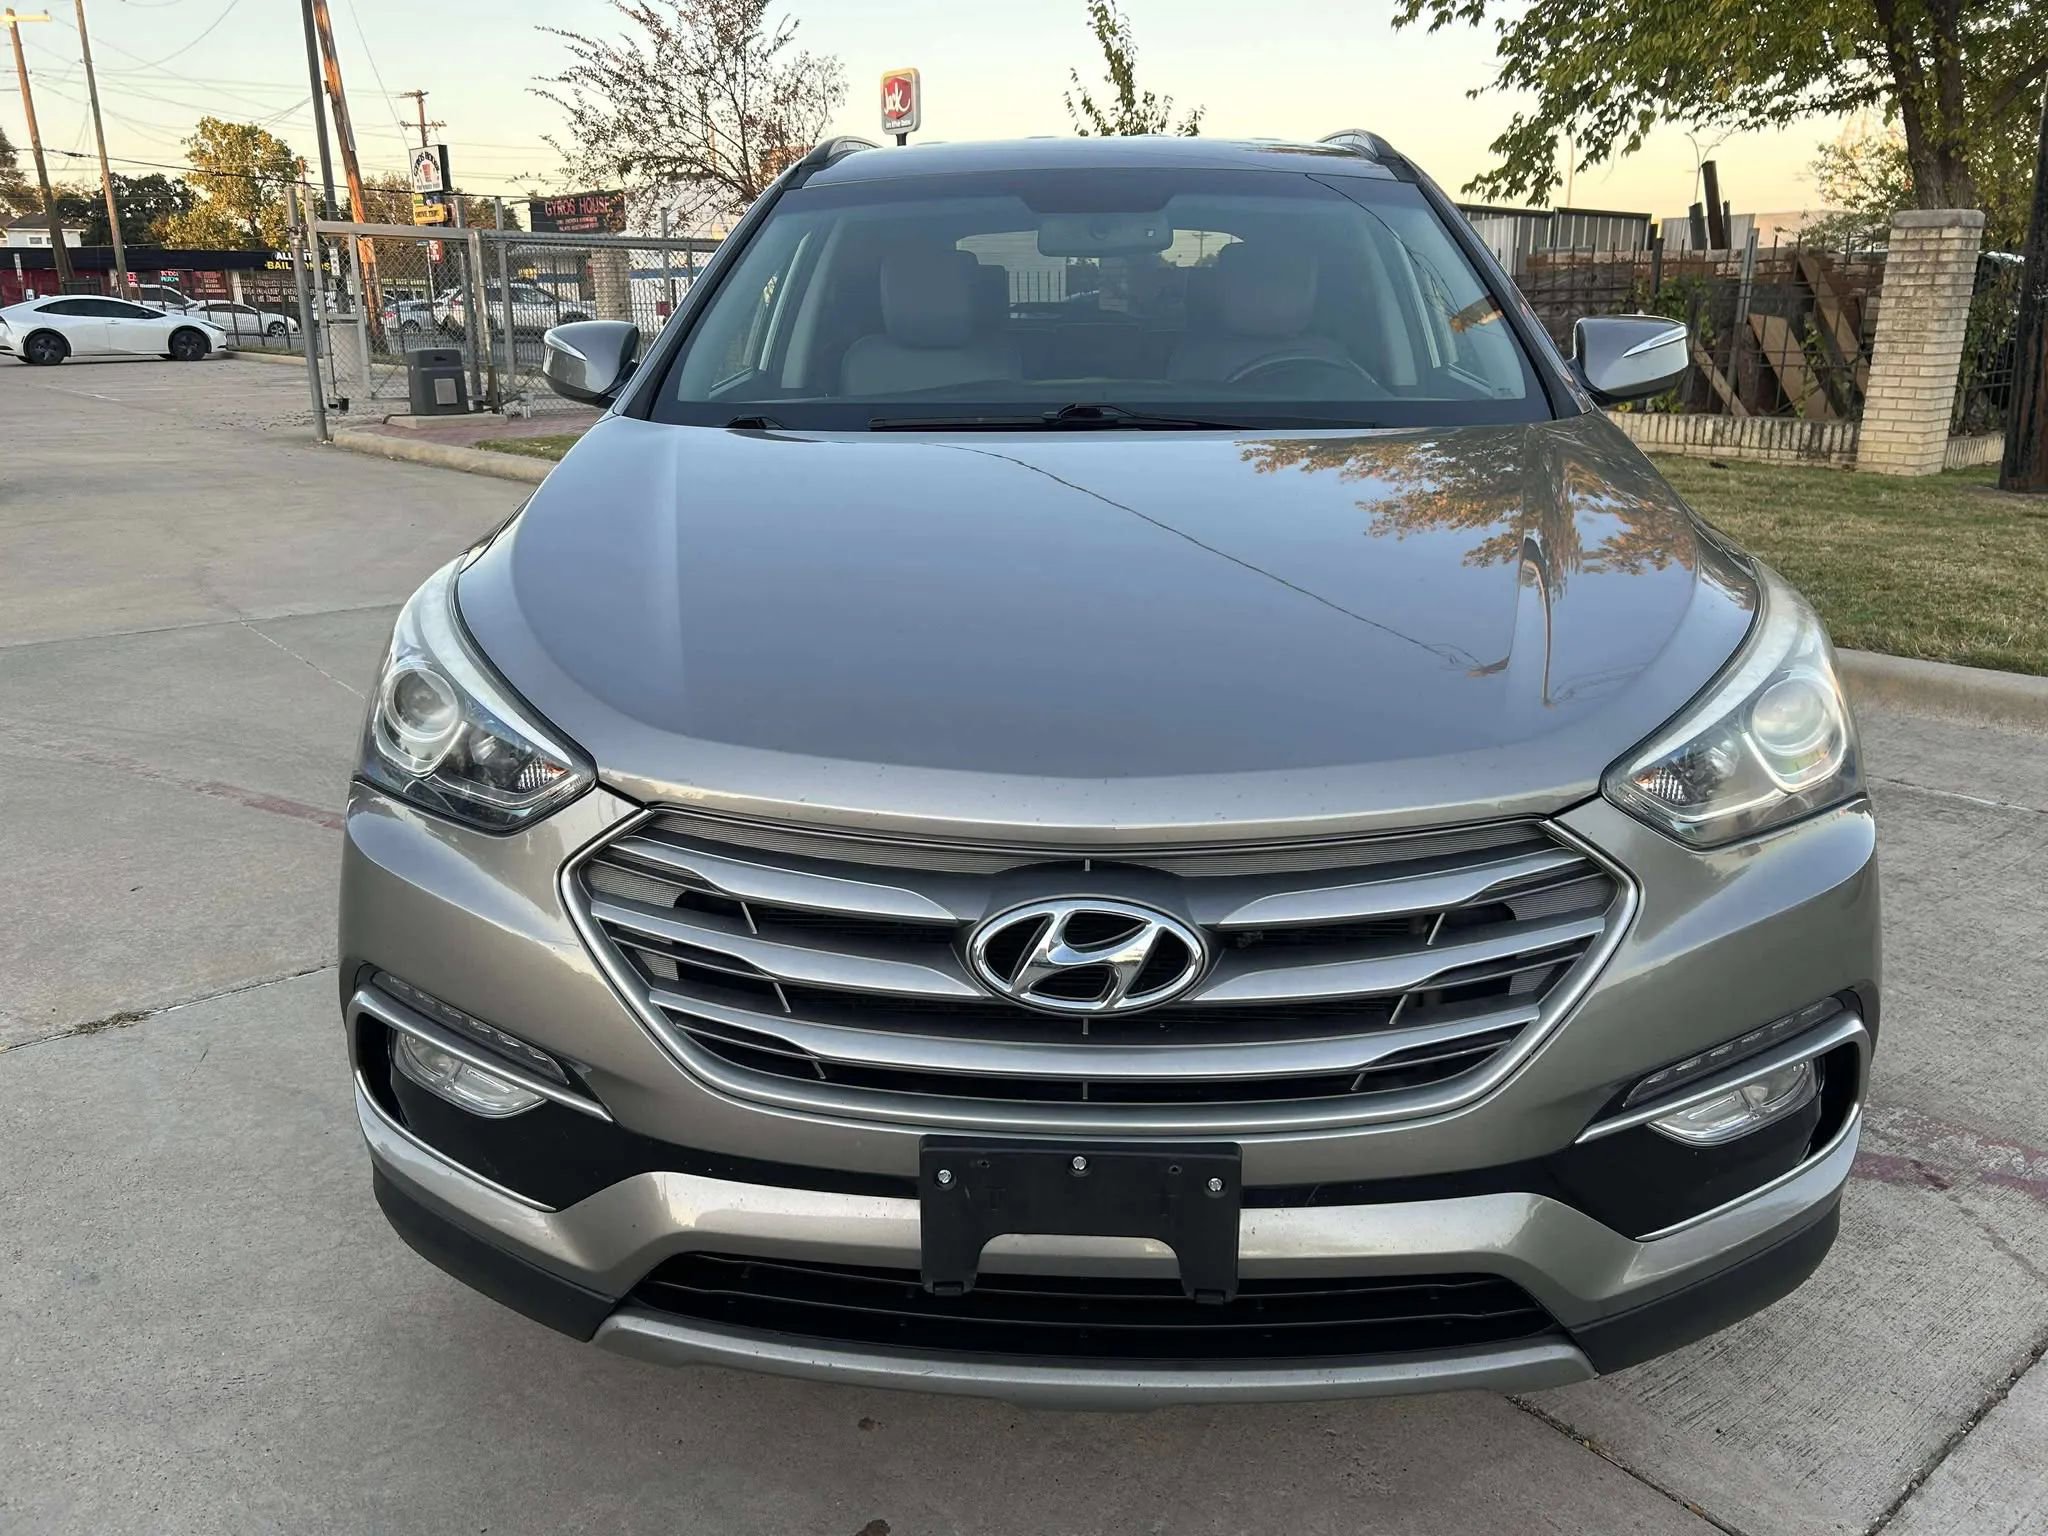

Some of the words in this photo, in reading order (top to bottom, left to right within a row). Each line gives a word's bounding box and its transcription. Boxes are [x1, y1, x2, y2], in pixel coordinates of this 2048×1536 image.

[884, 82, 910, 114] Jack
[544, 198, 576, 217] GYROS
[579, 196, 609, 214] HOUSE
[276, 252, 294, 260] ALL
[266, 261, 292, 270] BAIL
